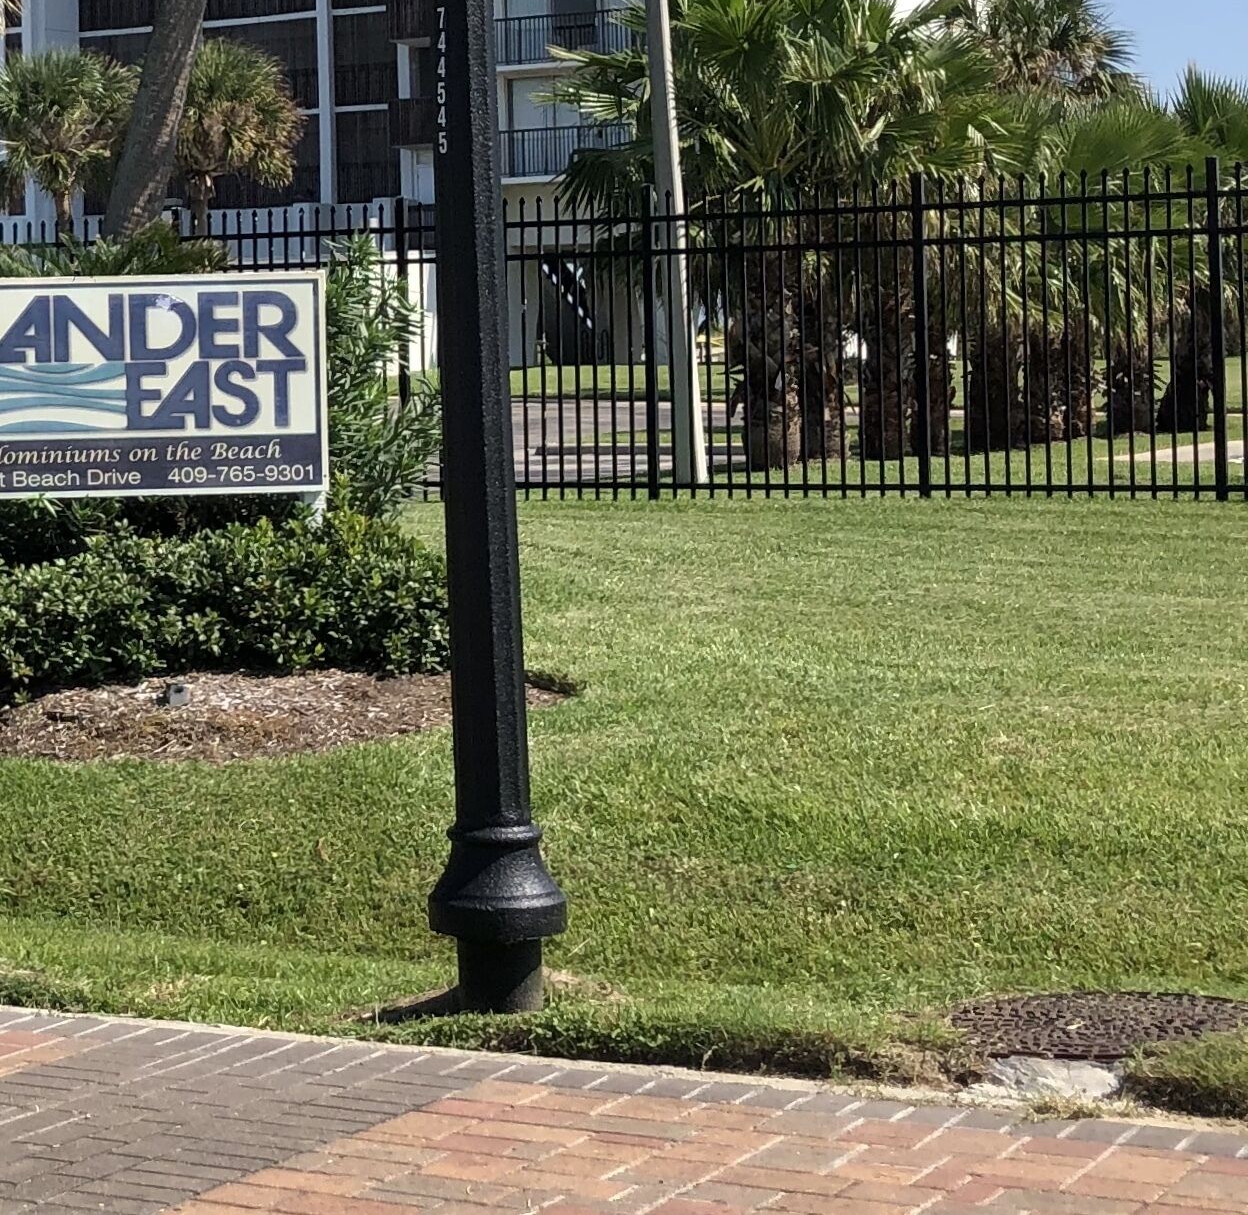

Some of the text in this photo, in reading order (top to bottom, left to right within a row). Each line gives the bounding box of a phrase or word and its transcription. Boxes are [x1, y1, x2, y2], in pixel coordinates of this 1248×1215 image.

[436, 6, 448, 154] 744545
[125, 359, 306, 430] EAST
[128, 447, 158, 462] on
[165, 441, 201, 461] the
[210, 439, 282, 460] Beach
[12, 469, 80, 487] Beach
[87, 467, 142, 485] Drive
[167, 464, 315, 483] 409-765-9301
